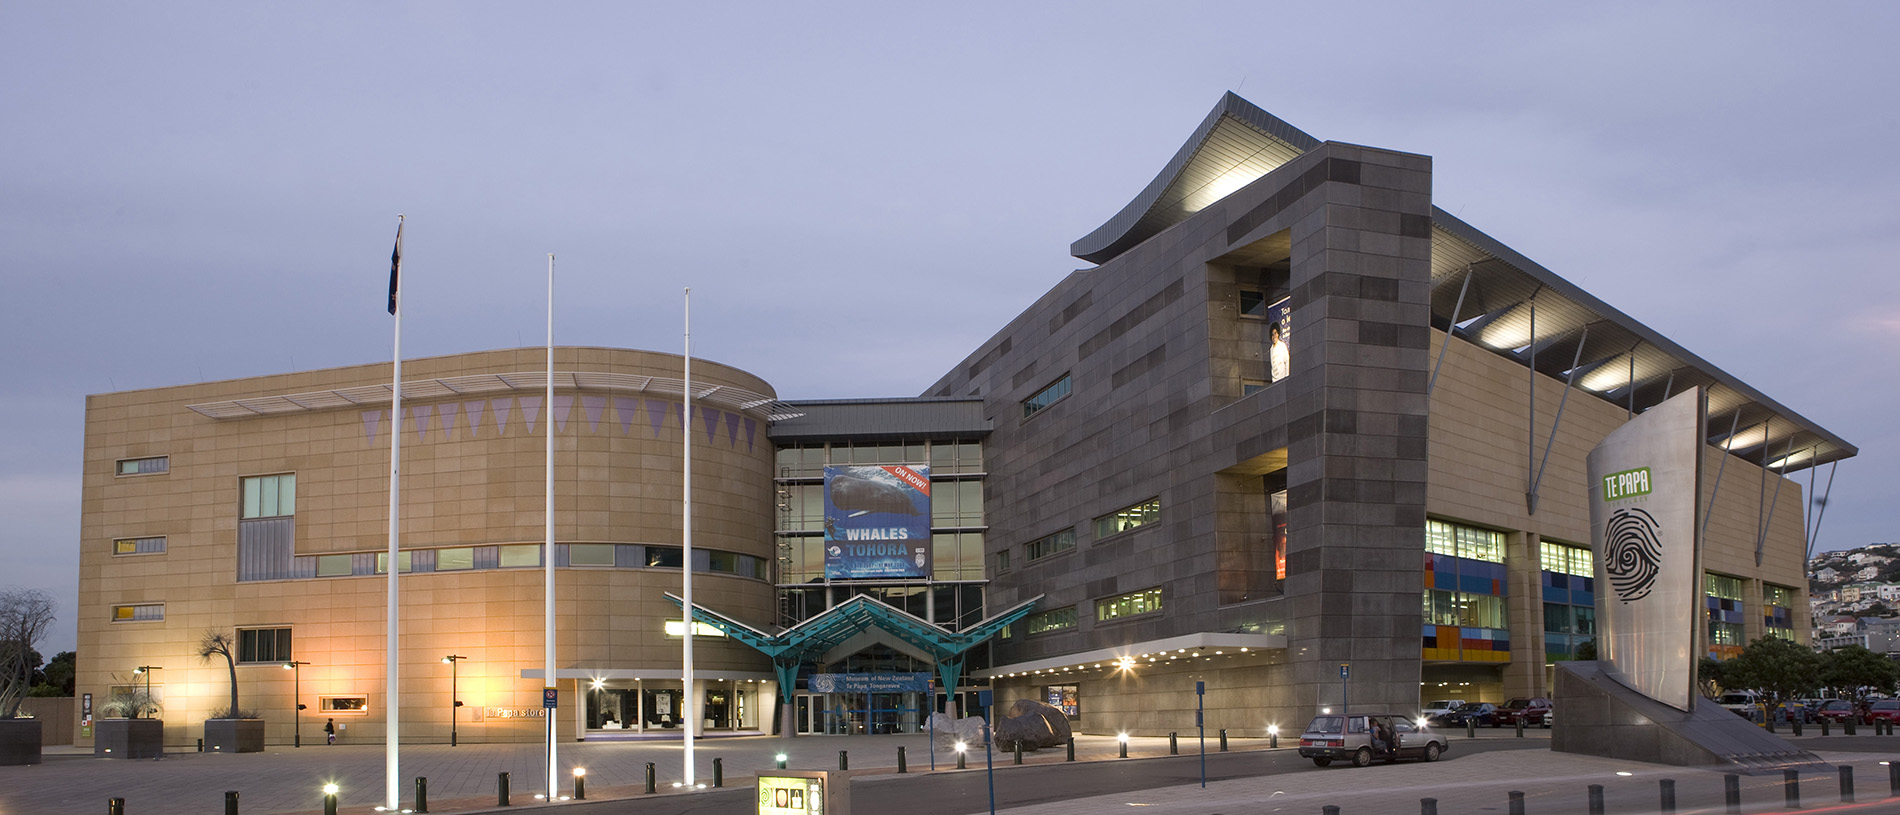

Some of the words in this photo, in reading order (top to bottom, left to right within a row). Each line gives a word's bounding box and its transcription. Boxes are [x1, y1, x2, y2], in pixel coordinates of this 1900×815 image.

[895, 467, 907, 477] ON
[905, 473, 927, 490] NOW!
[1605, 476, 1618, 498] TE
[1619, 470, 1649, 496] PAPA
[846, 528, 908, 540] WHALES
[497, 707, 520, 719] Papa
[521, 708, 545, 718] store
